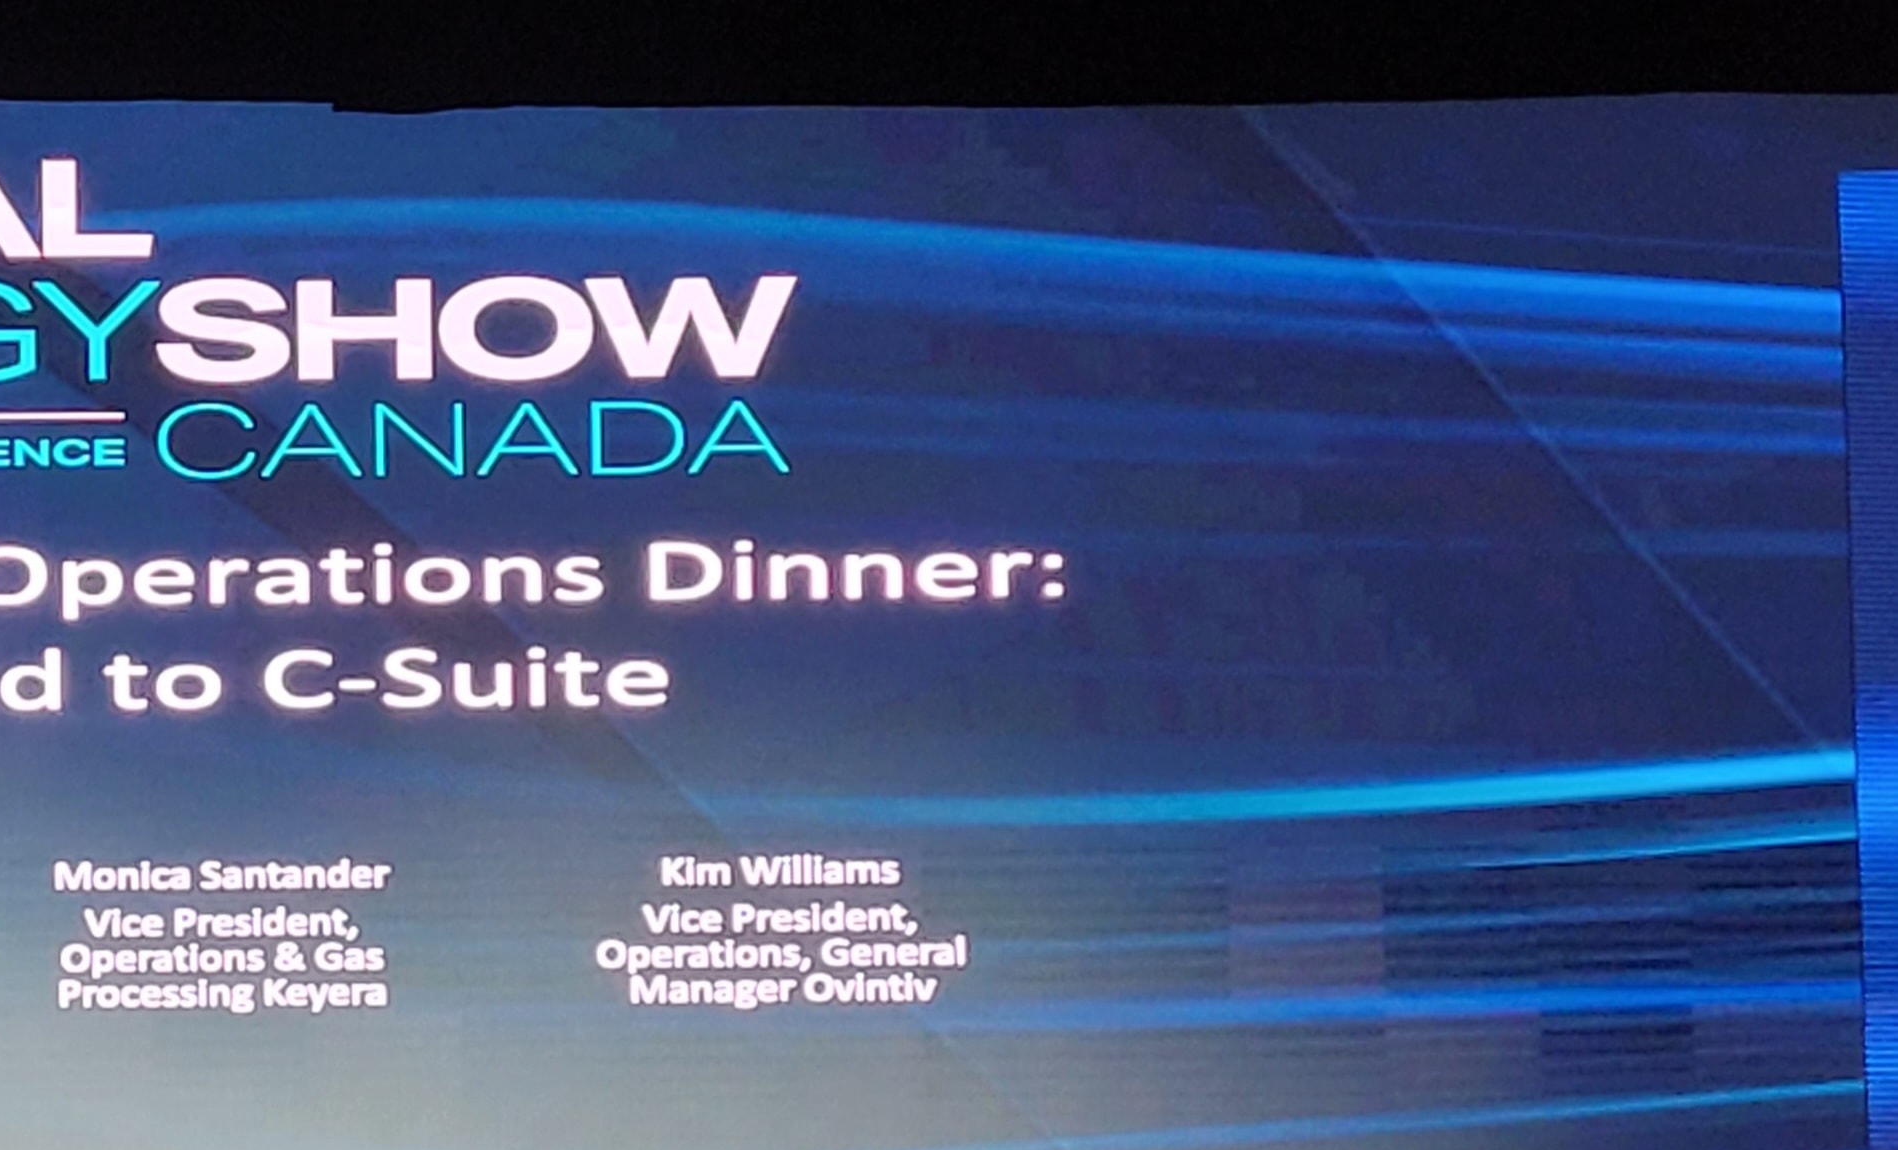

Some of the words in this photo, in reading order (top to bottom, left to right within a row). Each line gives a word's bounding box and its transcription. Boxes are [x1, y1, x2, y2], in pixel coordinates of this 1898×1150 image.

[157, 400, 790, 480] CANADA
[649, 540, 1063, 601] Dinner:
[103, 655, 222, 710] to
[264, 646, 669, 709] C-Suite
[54, 860, 191, 891] Monica
[199, 858, 391, 890] Santander
[661, 856, 731, 886] Kim
[739, 853, 900, 886] Williams
[84, 908, 164, 938] Vice
[174, 905, 359, 944] President,
[641, 903, 723, 934] Vice
[732, 901, 918, 936] President,
[60, 943, 265, 979] Operations
[273, 941, 307, 972] &
[314, 938, 385, 972] Gas
[595, 938, 817, 977] Operations,
[820, 932, 966, 967] General
[58, 975, 255, 1014] Processing
[265, 978, 387, 1013] Keyera
[629, 974, 797, 1010] Manager
[803, 971, 937, 1002] Ovintiv
